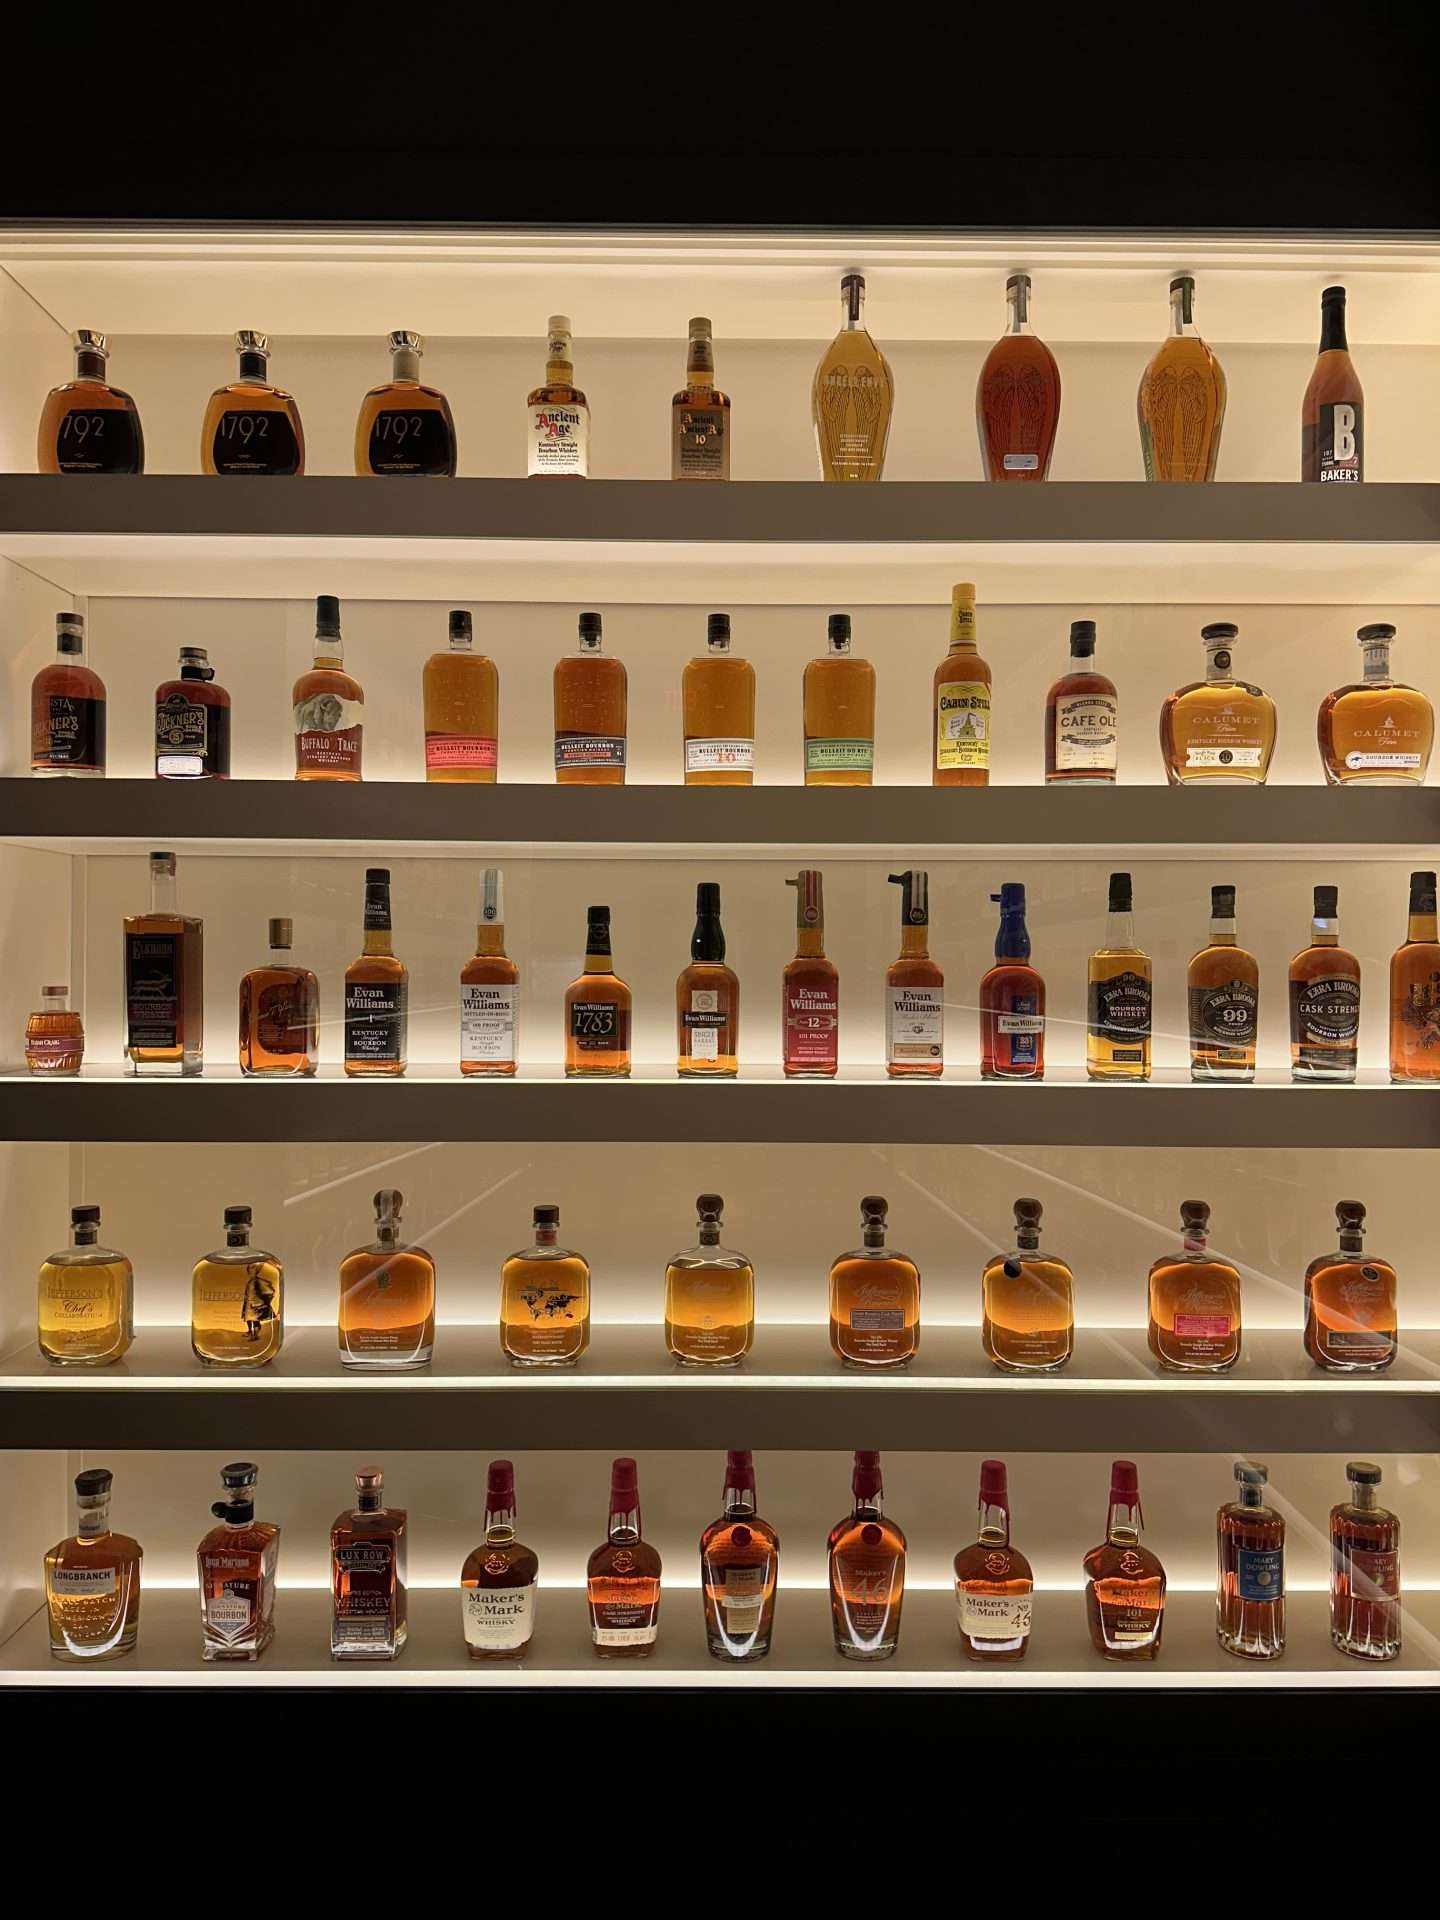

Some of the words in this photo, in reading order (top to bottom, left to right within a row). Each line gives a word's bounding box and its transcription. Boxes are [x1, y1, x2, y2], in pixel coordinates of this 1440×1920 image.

[221, 416, 269, 444] 1792
[375, 416, 422, 444] 1792
[545, 423, 571, 437] Age
[1333, 405, 1355, 460] B
[695, 434, 706, 444] 10
[1320, 468, 1359, 482] BAKER'S
[1061, 715, 1096, 728] CAFE
[1099, 715, 1117, 728] OLE
[1193, 716, 1260, 724] CALUMET
[1353, 729, 1421, 737] CALUMET
[301, 736, 330, 751] BUFFALO
[353, 987, 384, 998] Evan
[471, 988, 500, 999] Evan
[800, 988, 829, 999] Evan
[903, 991, 932, 1001] Evan
[346, 998, 394, 1009] Williams
[463, 999, 510, 1009] Williams
[790, 999, 837, 1010] Williams
[894, 1001, 941, 1012] Williams
[1300, 1004, 1323, 1014] CASK
[1223, 1009, 1248, 1022] 99
[575, 1012, 613, 1034] 1783
[807, 1018, 820, 1028] 12
[340, 1551, 359, 1560] LUX
[363, 1551, 384, 1560] ROW
[54, 1571, 111, 1580] LONGBRANCH
[848, 1577, 890, 1606] 46
[335, 1598, 390, 1607] WHISKEY
[469, 1593, 525, 1603] Maker's
[966, 1598, 1009, 1608] Maker's
[210, 1611, 247, 1619] BOURBON
[484, 1605, 524, 1615] Mark
[977, 1608, 1009, 1616] Mark
[1127, 1609, 1142, 1617] 101
